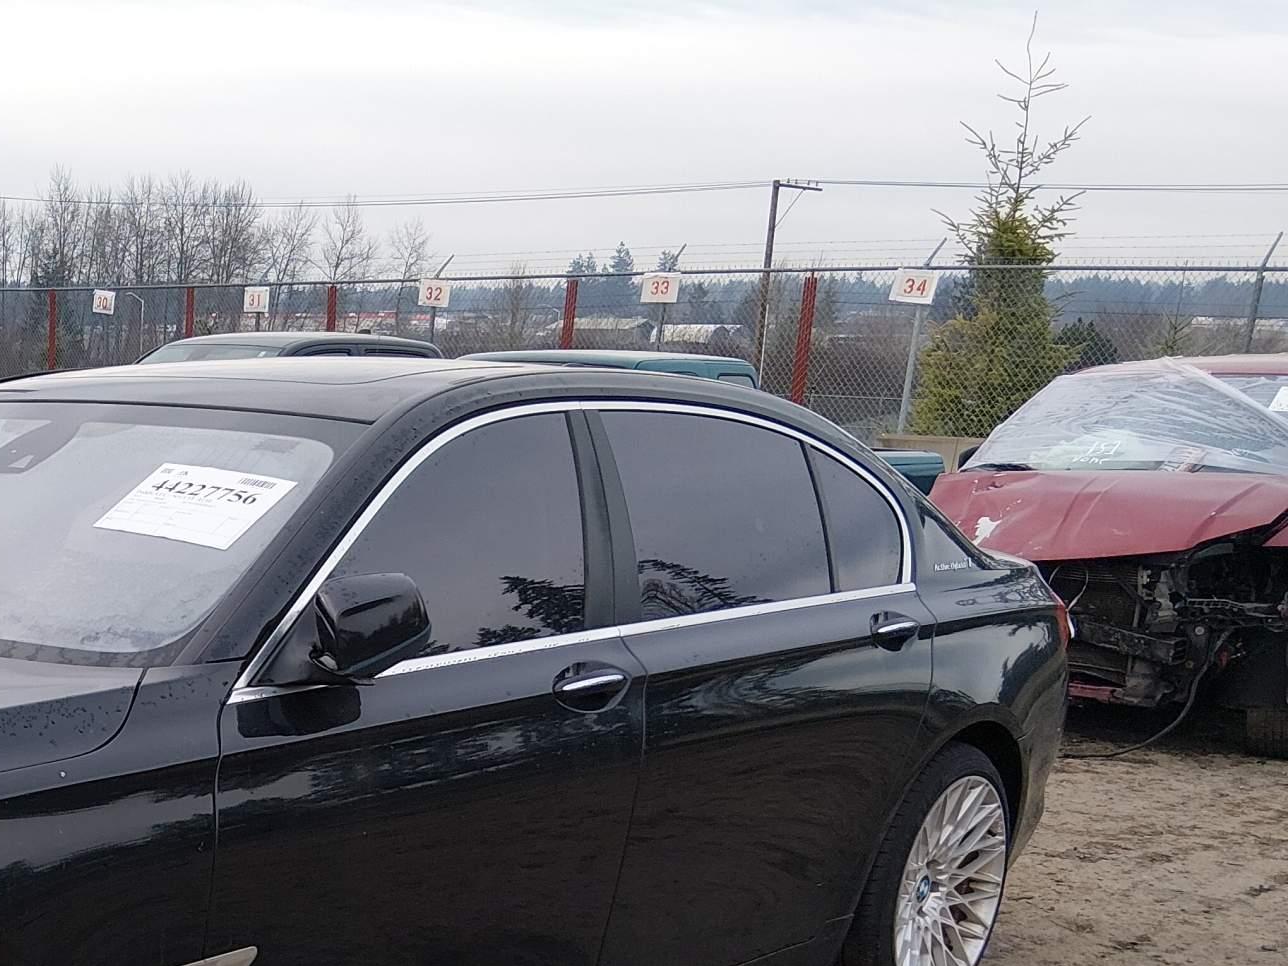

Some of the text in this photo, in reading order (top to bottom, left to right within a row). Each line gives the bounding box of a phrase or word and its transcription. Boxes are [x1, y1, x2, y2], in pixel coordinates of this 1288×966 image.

[425, 286, 442, 301] 32
[650, 280, 669, 295] 33
[903, 278, 928, 296] 34
[96, 296, 108, 310] 30
[248, 294, 261, 307] 31
[151, 479, 263, 505] 44227756
